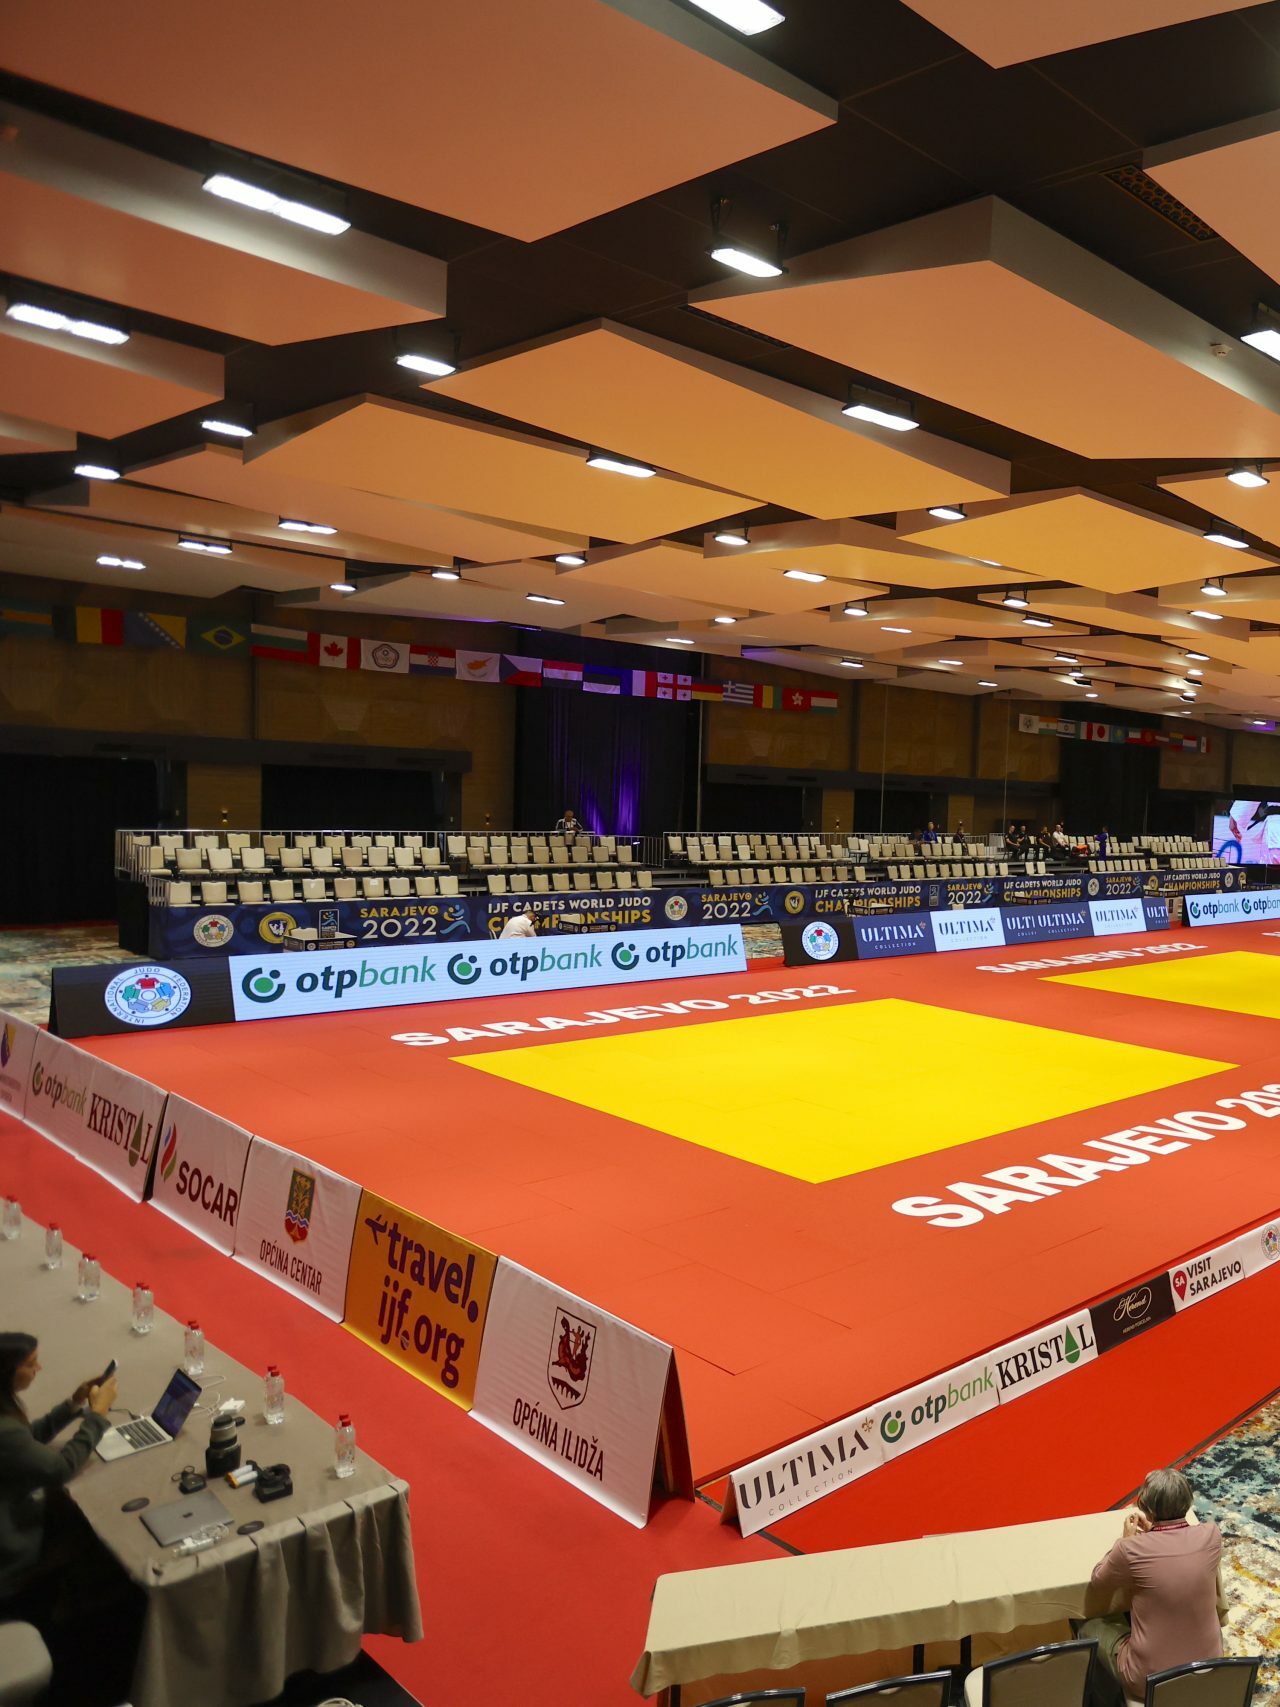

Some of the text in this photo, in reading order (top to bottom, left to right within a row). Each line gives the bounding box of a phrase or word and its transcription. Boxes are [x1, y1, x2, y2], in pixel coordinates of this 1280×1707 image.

[1003, 878, 1082, 890] IJF CADETS WORLD JUDO
[1172, 873, 1191, 881] CADETS
[1191, 872, 1208, 880] WORLD
[1208, 871, 1221, 879] JUDO
[701, 892, 752, 903] SARAJEVO
[815, 889, 828, 899] IJF
[867, 886, 896, 897] WORLD
[899, 885, 921, 895] JUDO
[947, 883, 983, 892] SARAJEVO
[947, 891, 982, 905] 2022
[1106, 883, 1132, 895] 2022
[360, 905, 439, 918] SARAJEVO
[488, 896, 651, 914] IJF CADETS WORLD JUDO
[702, 902, 751, 920] 2022
[1095, 908, 1137, 922] ULTIMA
[1202, 901, 1239, 919] otpbank
[361, 917, 437, 940] 2022
[938, 919, 994, 936] ULTIMA
[1038, 911, 1085, 928] ULTIMA
[860, 924, 925, 943] ULTIMA
[874, 942, 916, 950] COLLECTION
[134, 967, 160, 975] JUDO
[295, 934, 738, 998] otpbank otpbank otpbank
[107, 977, 145, 1024] INTERNATIONAL
[171, 974, 190, 1017] FEDERATION
[390, 984, 857, 1047] SARAJEVO 2022
[44, 1074, 87, 1117] otpbank
[86, 1092, 154, 1168] KRISTAL
[891, 1110, 1247, 1228] SARAJEVO
[175, 1160, 239, 1228] SOCAR
[259, 1239, 323, 1296] OPĆINA CENTAR
[387, 1221, 480, 1324] travel.
[1186, 1257, 1212, 1279] VISIT
[1189, 1260, 1242, 1297] SARAJEVO
[1174, 1276, 1186, 1288] SA
[1113, 1286, 1152, 1322] Herend
[377, 1275, 465, 1390] ijf.org
[996, 1323, 1094, 1390] KRISTAL
[910, 1367, 994, 1426] otpbank
[513, 1398, 605, 1482] OPĆINA ILIDŽA
[738, 1429, 870, 1509] ULTIMA
[768, 1467, 854, 1516] COLLECTION
